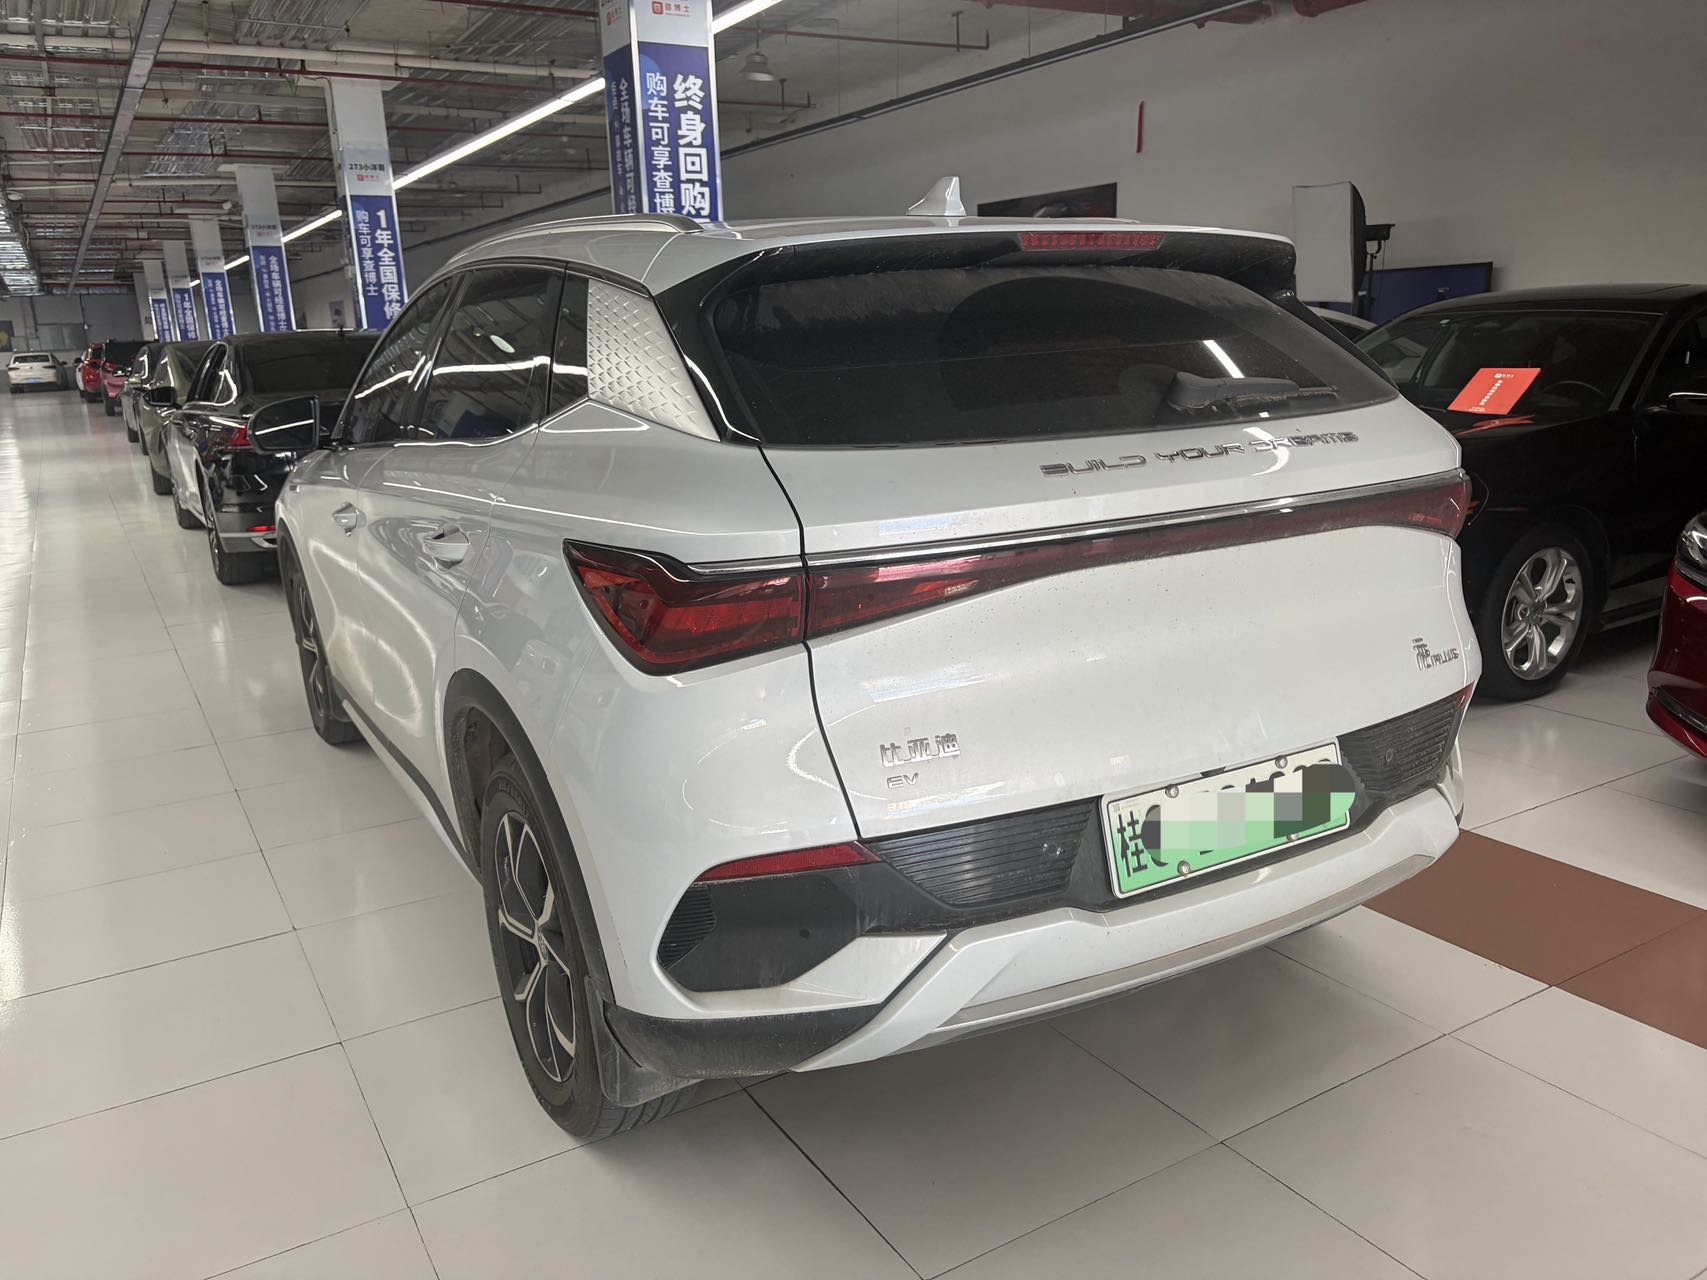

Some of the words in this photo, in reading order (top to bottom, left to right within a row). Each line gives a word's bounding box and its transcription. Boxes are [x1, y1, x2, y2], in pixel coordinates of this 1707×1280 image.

[673, 73, 712, 223] 终身回购
[1039, 455, 1147, 478] BUILD
[1154, 442, 1246, 464] YOUR
[1248, 431, 1360, 453] DREAMS
[879, 732, 961, 768] 比亚迪
[886, 772, 919, 790] EV
